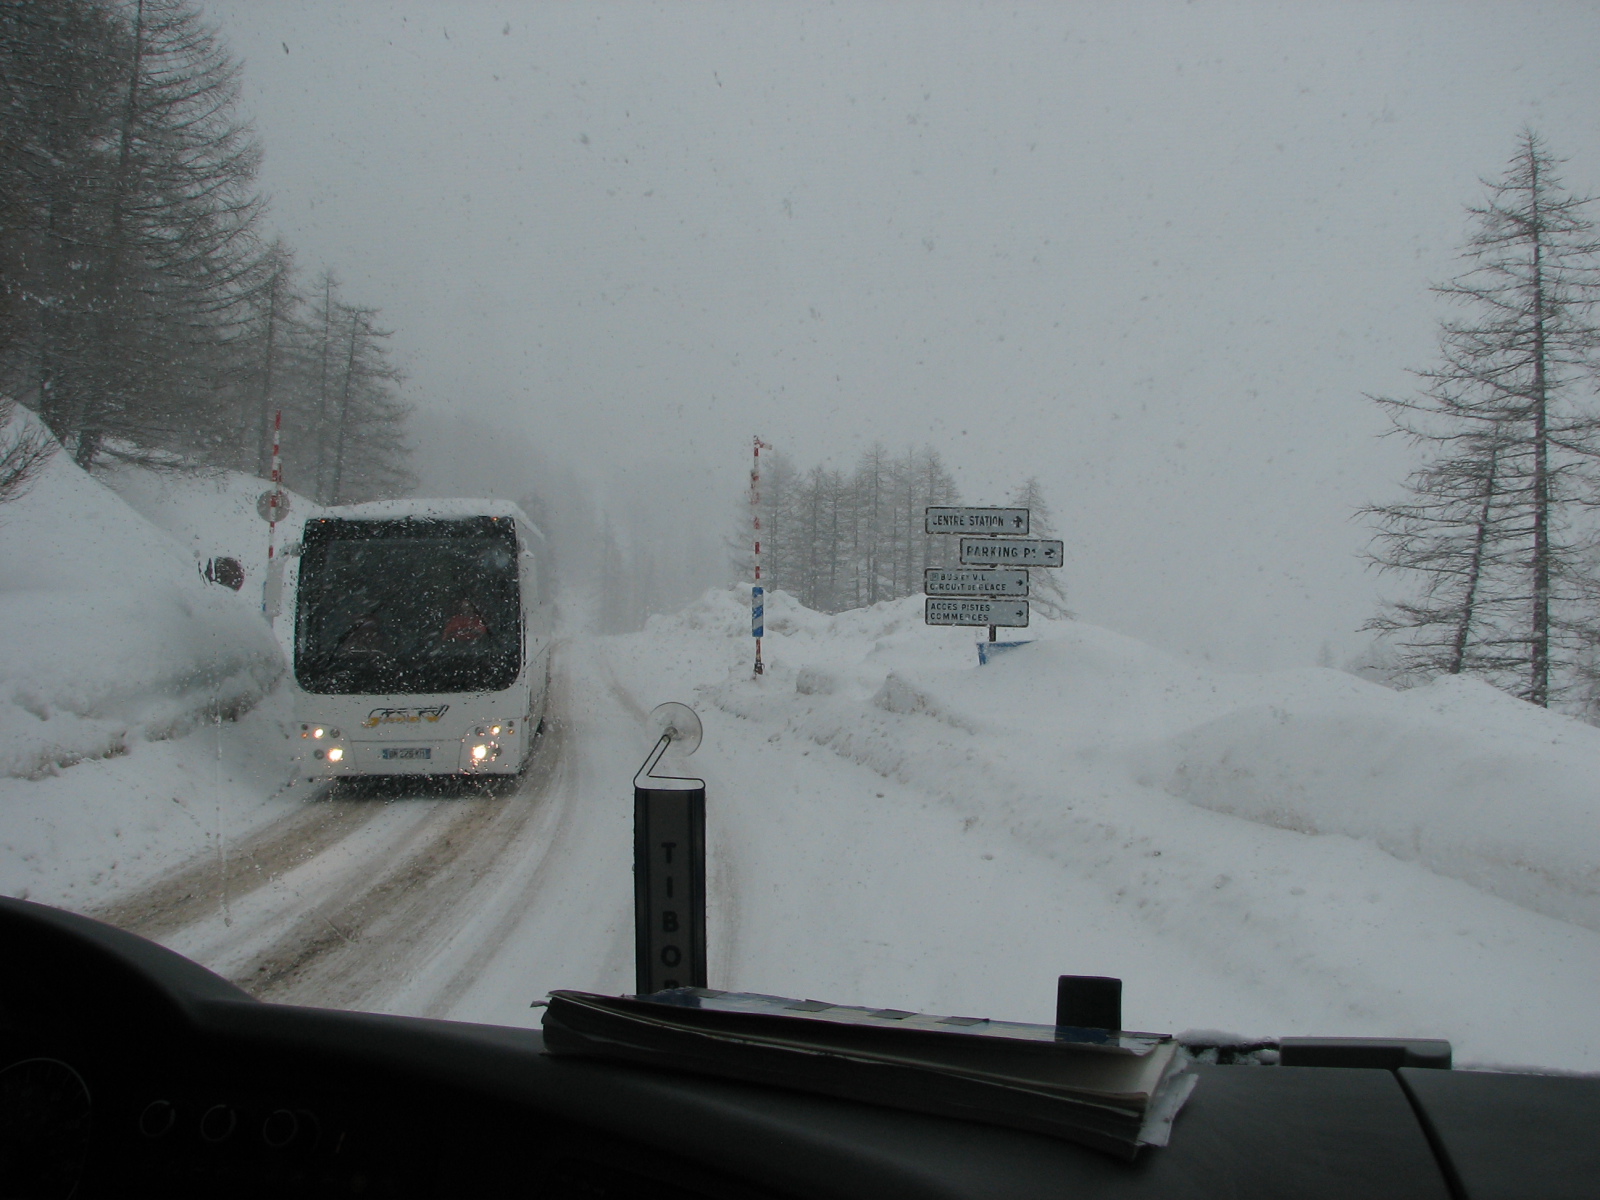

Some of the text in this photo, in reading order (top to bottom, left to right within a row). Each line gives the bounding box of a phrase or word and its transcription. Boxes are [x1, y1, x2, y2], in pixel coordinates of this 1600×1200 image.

[969, 515, 1004, 527] STATION
[966, 545, 1018, 558] PARKING
[961, 603, 991, 612] PISTES
